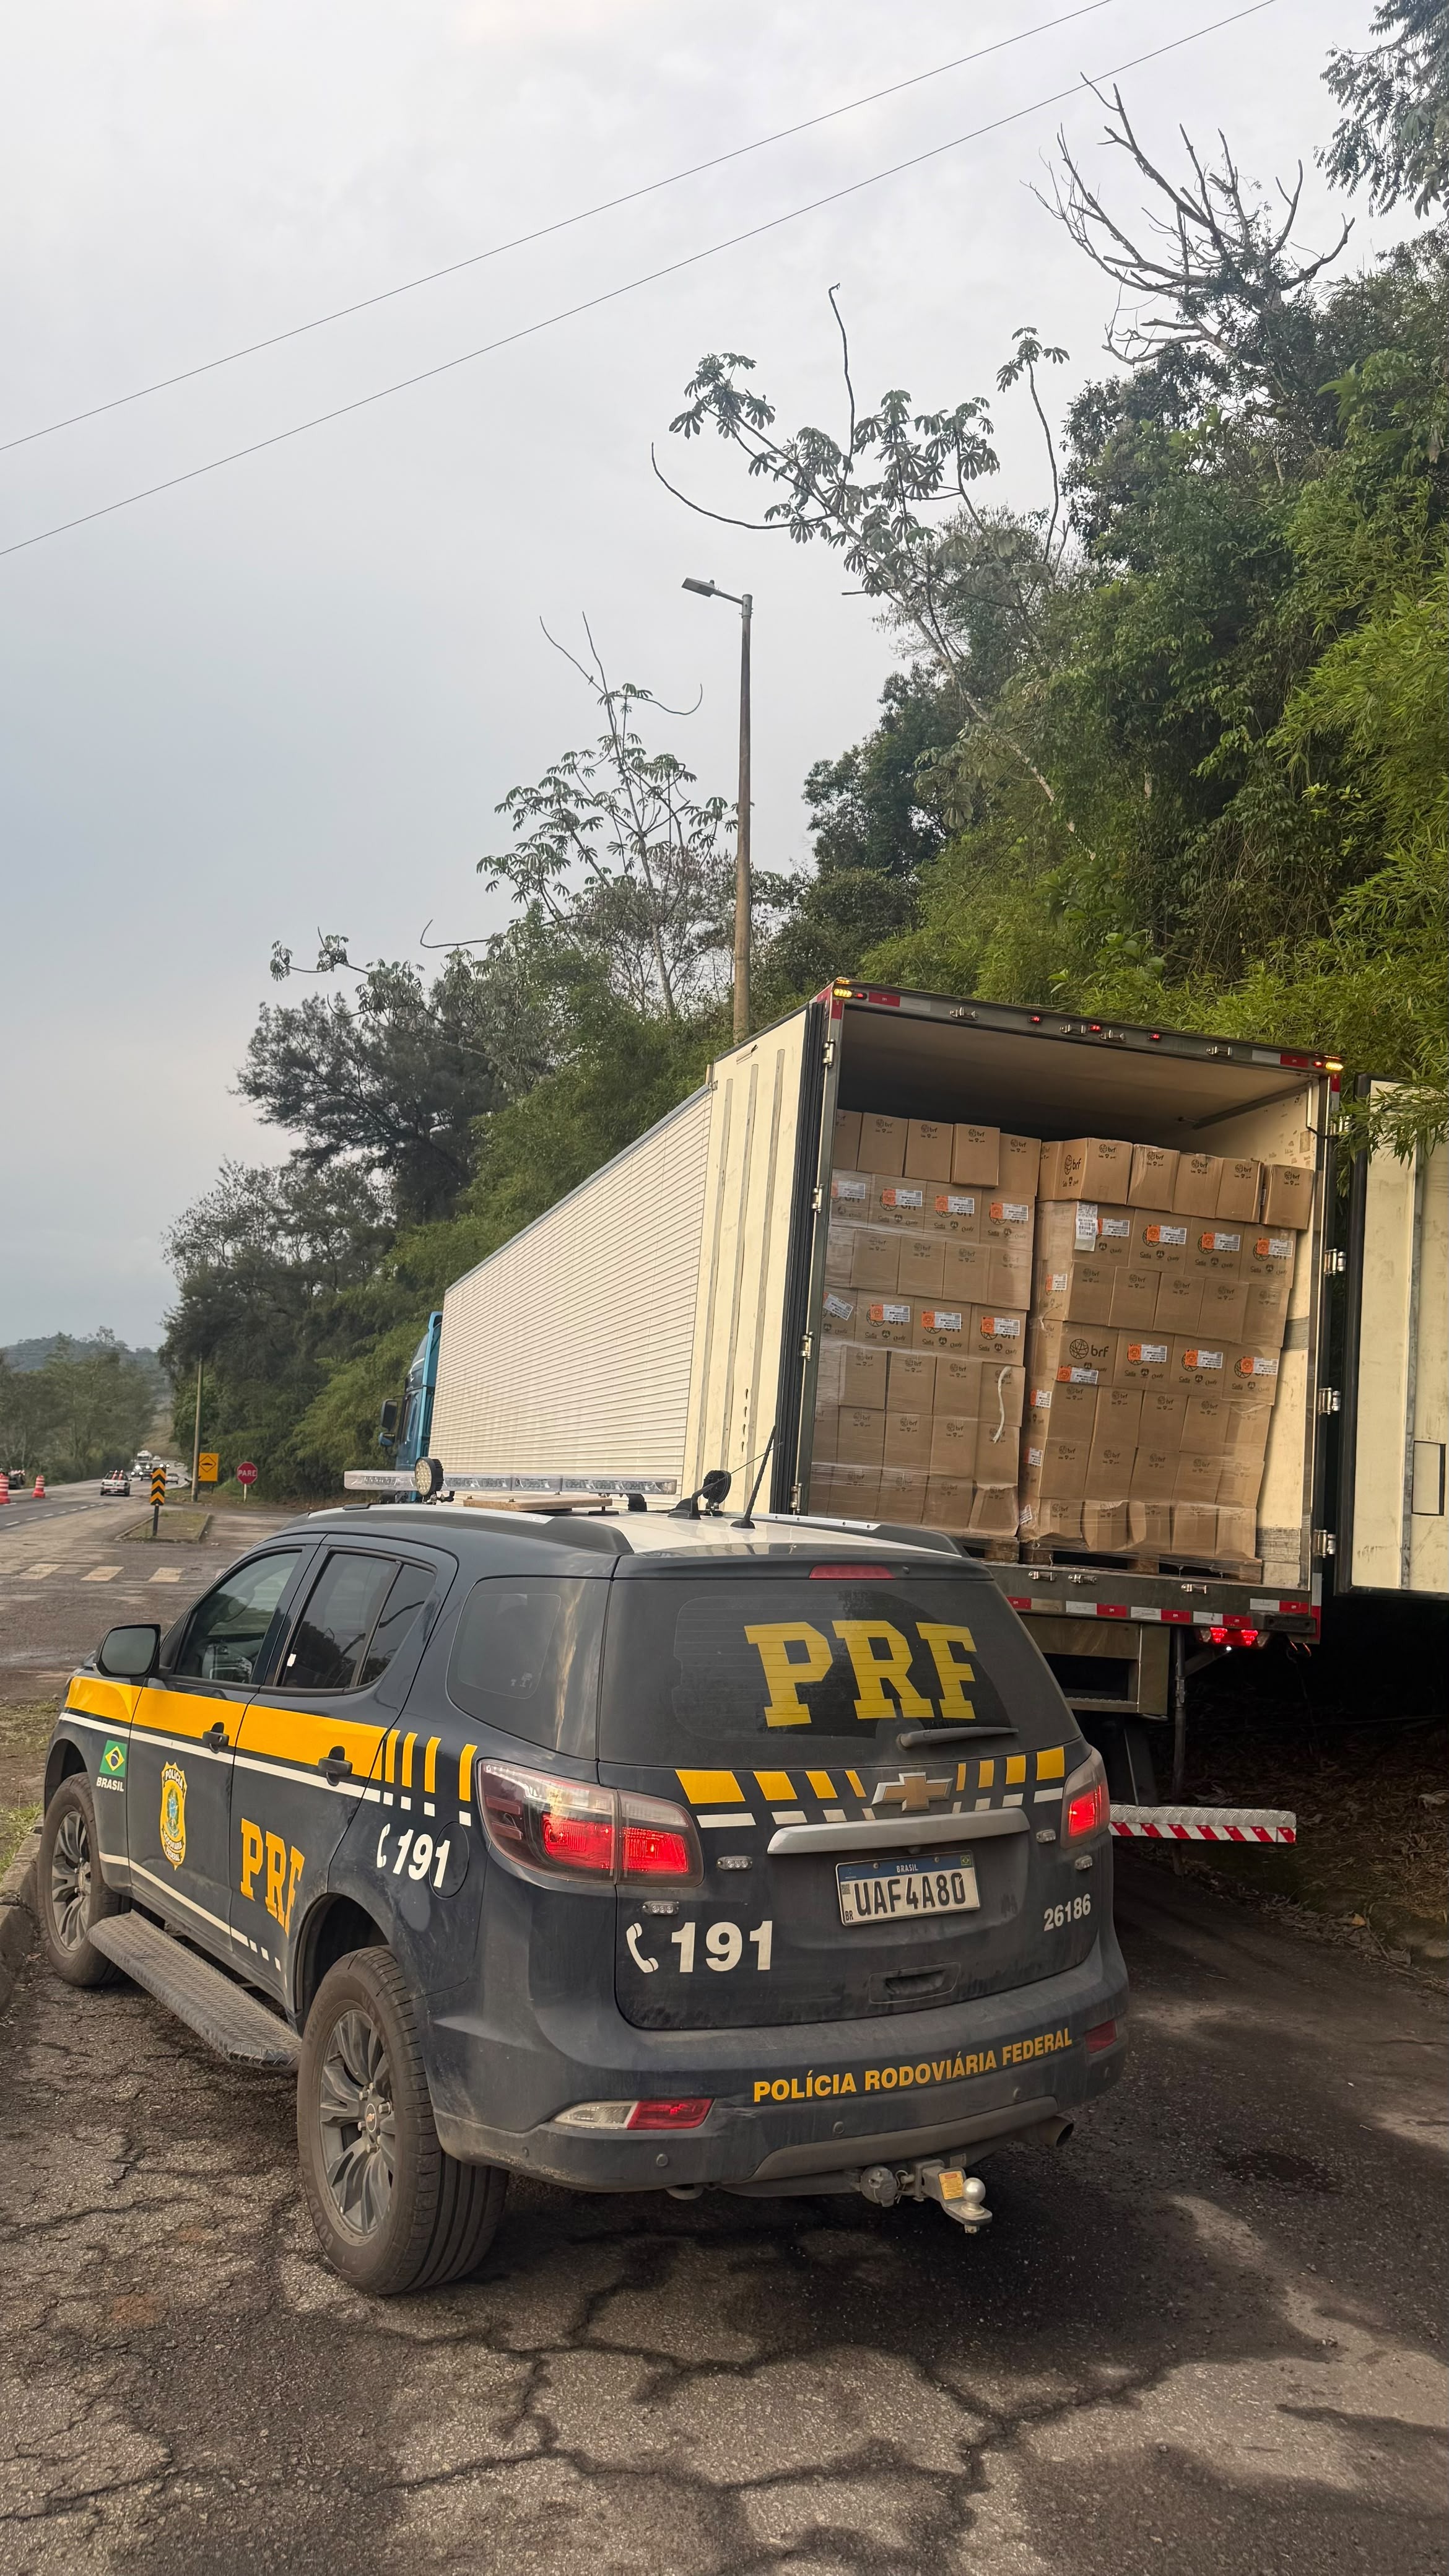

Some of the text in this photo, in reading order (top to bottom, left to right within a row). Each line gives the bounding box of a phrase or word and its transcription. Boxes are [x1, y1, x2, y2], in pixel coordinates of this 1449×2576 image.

[1072, 1158, 1081, 1170] brf
[1091, 1345, 1110, 1357] brf
[744, 1620, 977, 1728] PRF
[96, 1776, 124, 1792] BRASIL
[240, 1817, 305, 1939] PRF
[393, 1829, 451, 1888] 191
[896, 1863, 919, 1873] BRASIL
[854, 1872, 966, 1917] UAF4A80
[1043, 1893, 1091, 1931] 26186
[845, 1910, 853, 1921] BR
[671, 1920, 773, 1973] 191
[754, 2027, 1073, 2102] POLÍCIA RODOVIÁRIA FEDERAL
